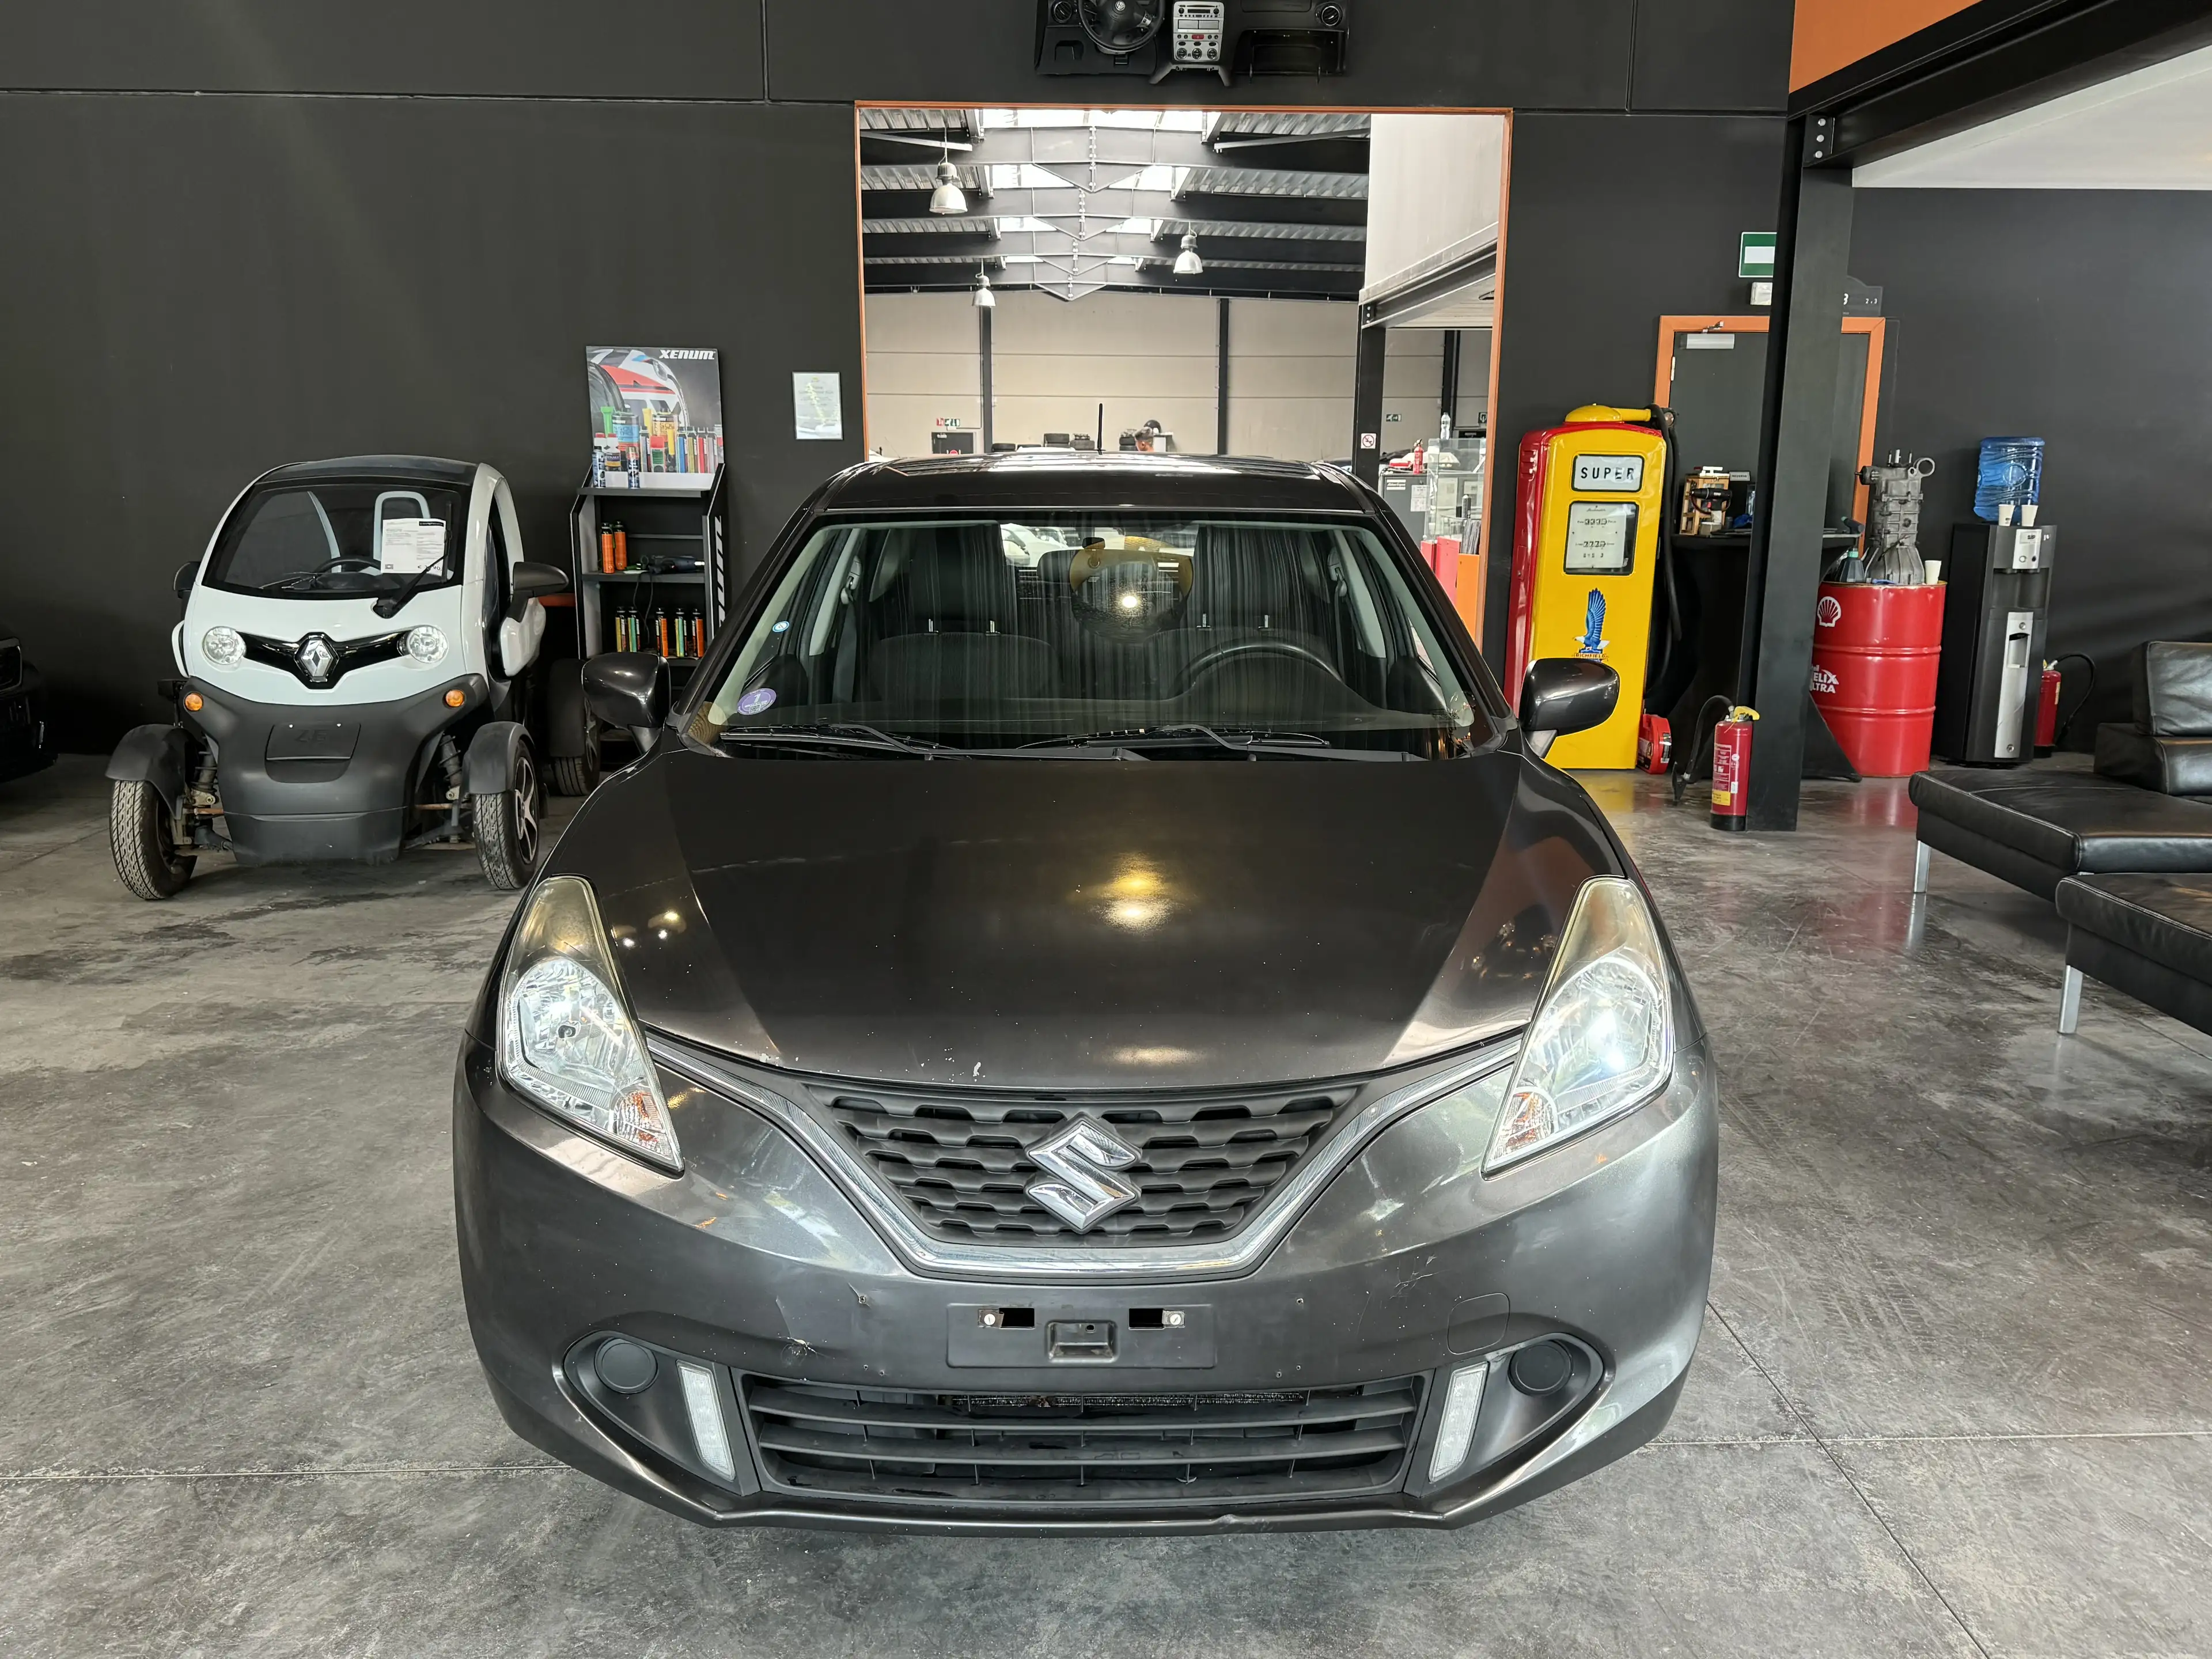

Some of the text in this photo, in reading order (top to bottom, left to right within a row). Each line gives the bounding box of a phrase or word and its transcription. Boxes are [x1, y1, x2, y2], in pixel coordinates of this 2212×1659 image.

[658, 349, 715, 360] XENUM
[1581, 467, 1634, 480] SUPER
[1813, 669, 1839, 685] ELIX
